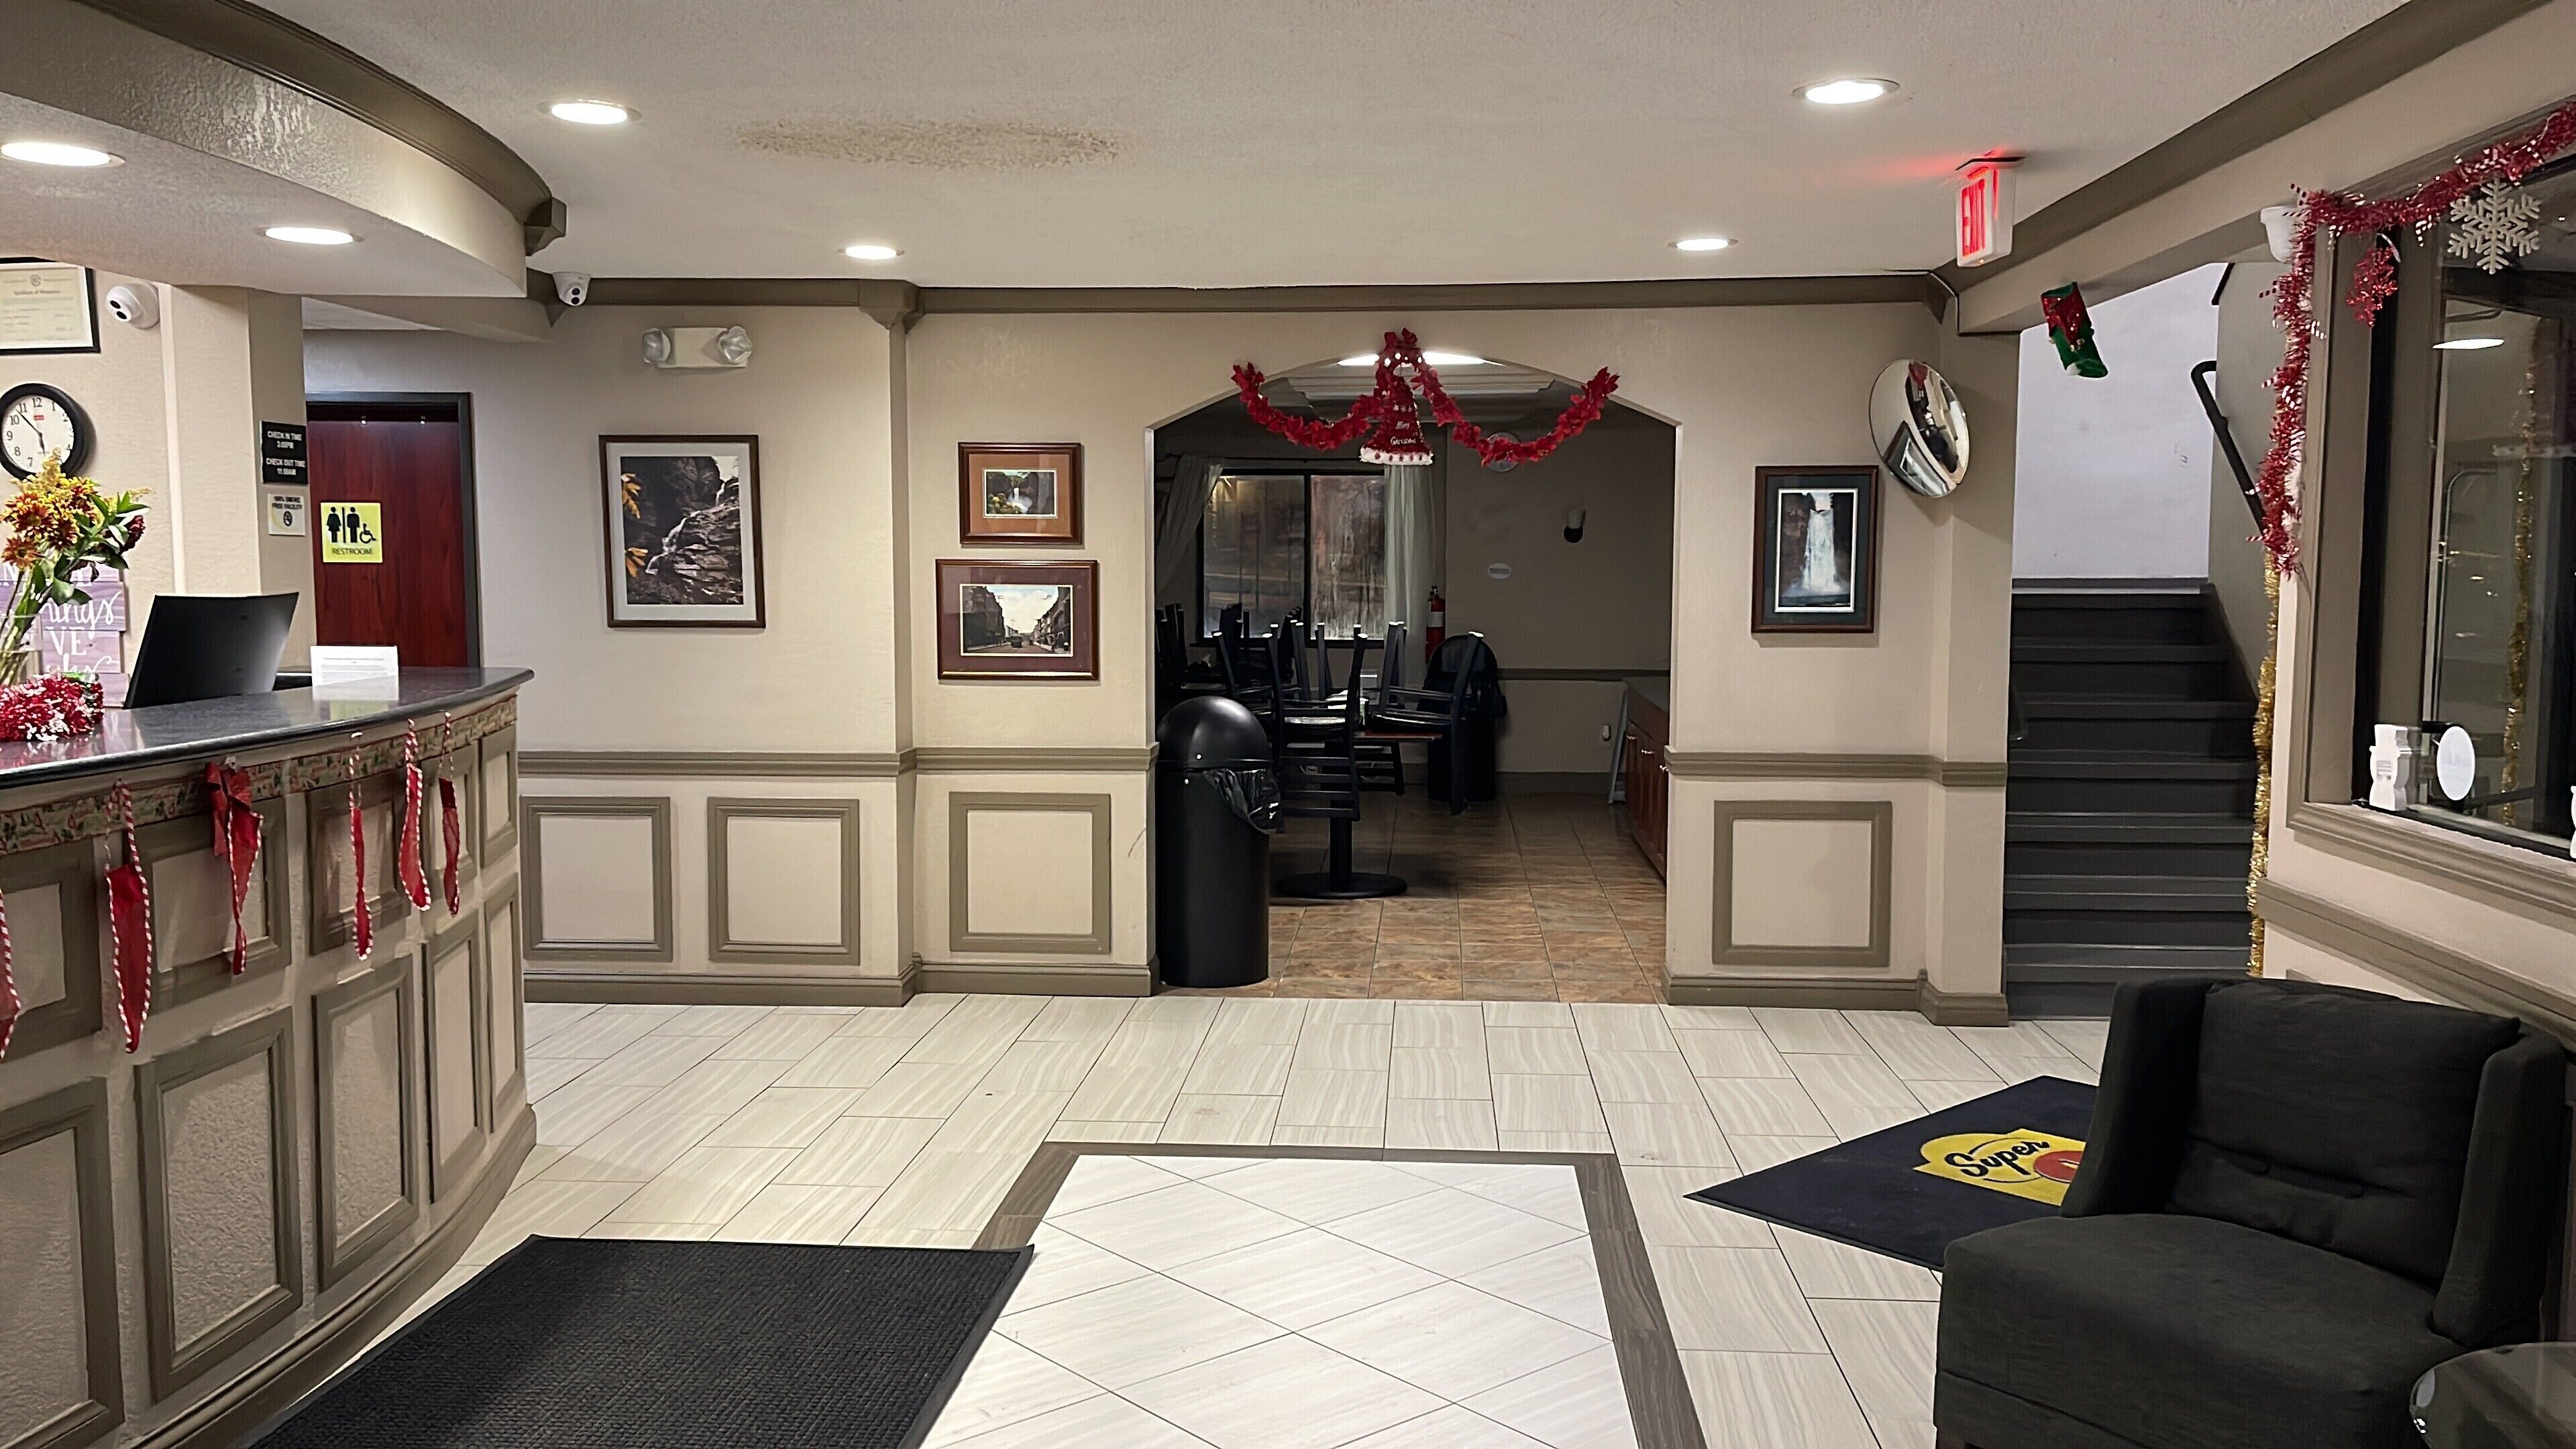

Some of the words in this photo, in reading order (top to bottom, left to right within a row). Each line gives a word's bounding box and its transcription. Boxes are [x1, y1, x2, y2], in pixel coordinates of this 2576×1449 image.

[1962, 179, 1986, 257] EXIT
[32, 397, 42, 407] 12
[52, 402, 56, 411] 1
[18, 403, 27, 413] 11
[10, 415, 20, 425] 10
[6, 431, 13, 441] 9
[14, 446, 21, 456] 8
[27, 458, 33, 468] 7
[266, 458, 283, 466] CHECK
[331, 547, 373, 555] RESTROOM
[1945, 1141, 2050, 1177] Super
